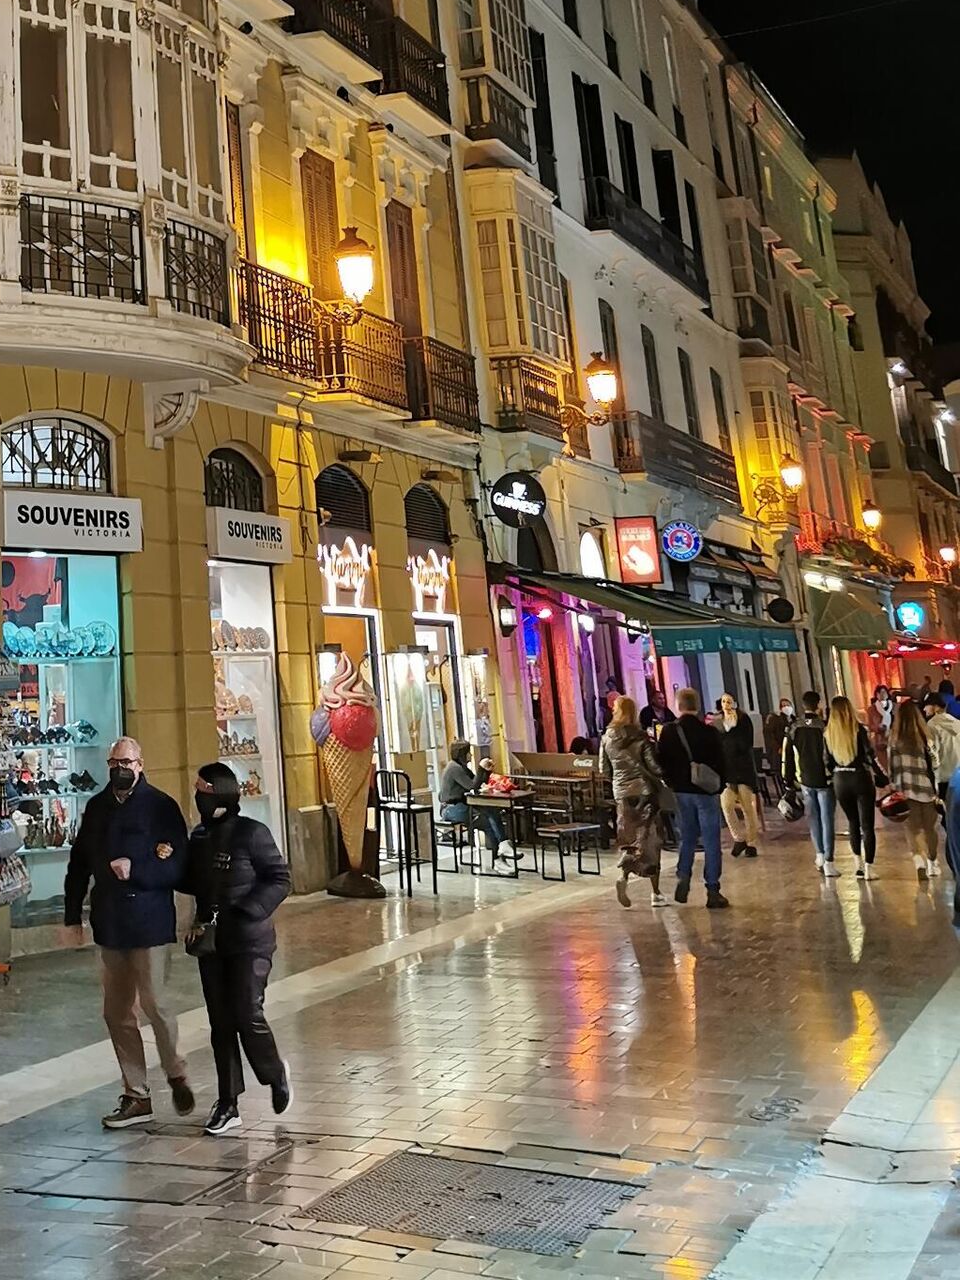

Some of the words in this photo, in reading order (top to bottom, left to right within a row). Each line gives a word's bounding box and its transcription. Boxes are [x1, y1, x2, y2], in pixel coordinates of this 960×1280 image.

[17, 504, 130, 529] SOUVENIRS
[74, 528, 130, 537] VICTORIA
[228, 520, 282, 543] SOUVENIRS
[256, 541, 283, 550] VICTORIA
